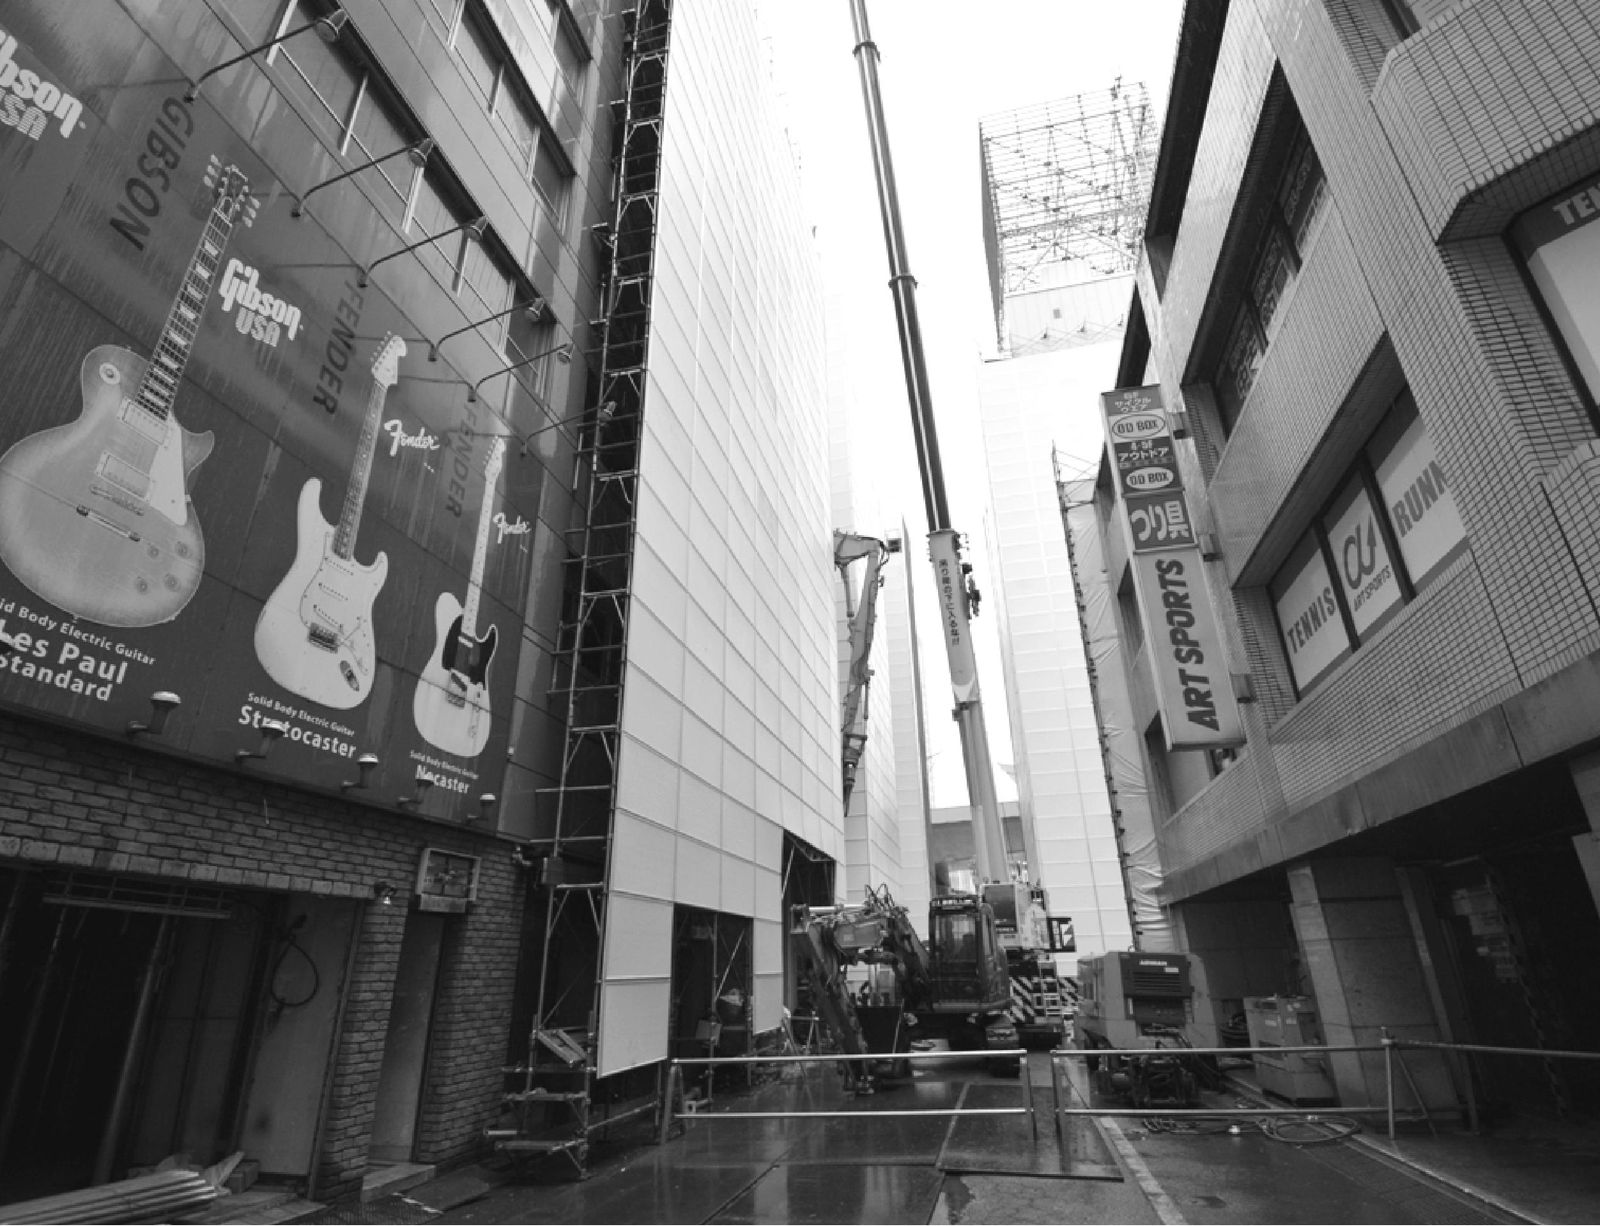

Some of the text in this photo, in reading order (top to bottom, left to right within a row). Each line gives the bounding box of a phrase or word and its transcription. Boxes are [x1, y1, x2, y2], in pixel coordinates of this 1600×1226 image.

[0, 29, 83, 139] bson
[0, 87, 48, 141] SA
[109, 97, 193, 251] GIBSON
[218, 258, 301, 341] Gibson
[235, 307, 281, 347] USA
[313, 280, 364, 415] FENDER
[384, 419, 440, 457] Fender
[445, 404, 478, 518] FENDER
[1117, 446, 1170, 462] アウトドア
[493, 512, 533, 545] Fender
[1131, 501, 1190, 541] つり具
[18, 605, 57, 631] Body
[60, 622, 113, 651] Electric
[115, 642, 156, 666] Guitar
[1155, 558, 1220, 732] ART SPORTS
[1286, 586, 1337, 654] TENNIS
[58, 641, 128, 685] Paul
[238, 704, 357, 759] Strtocaster
[248, 692, 355, 737] Solid Body Electric Guitar
